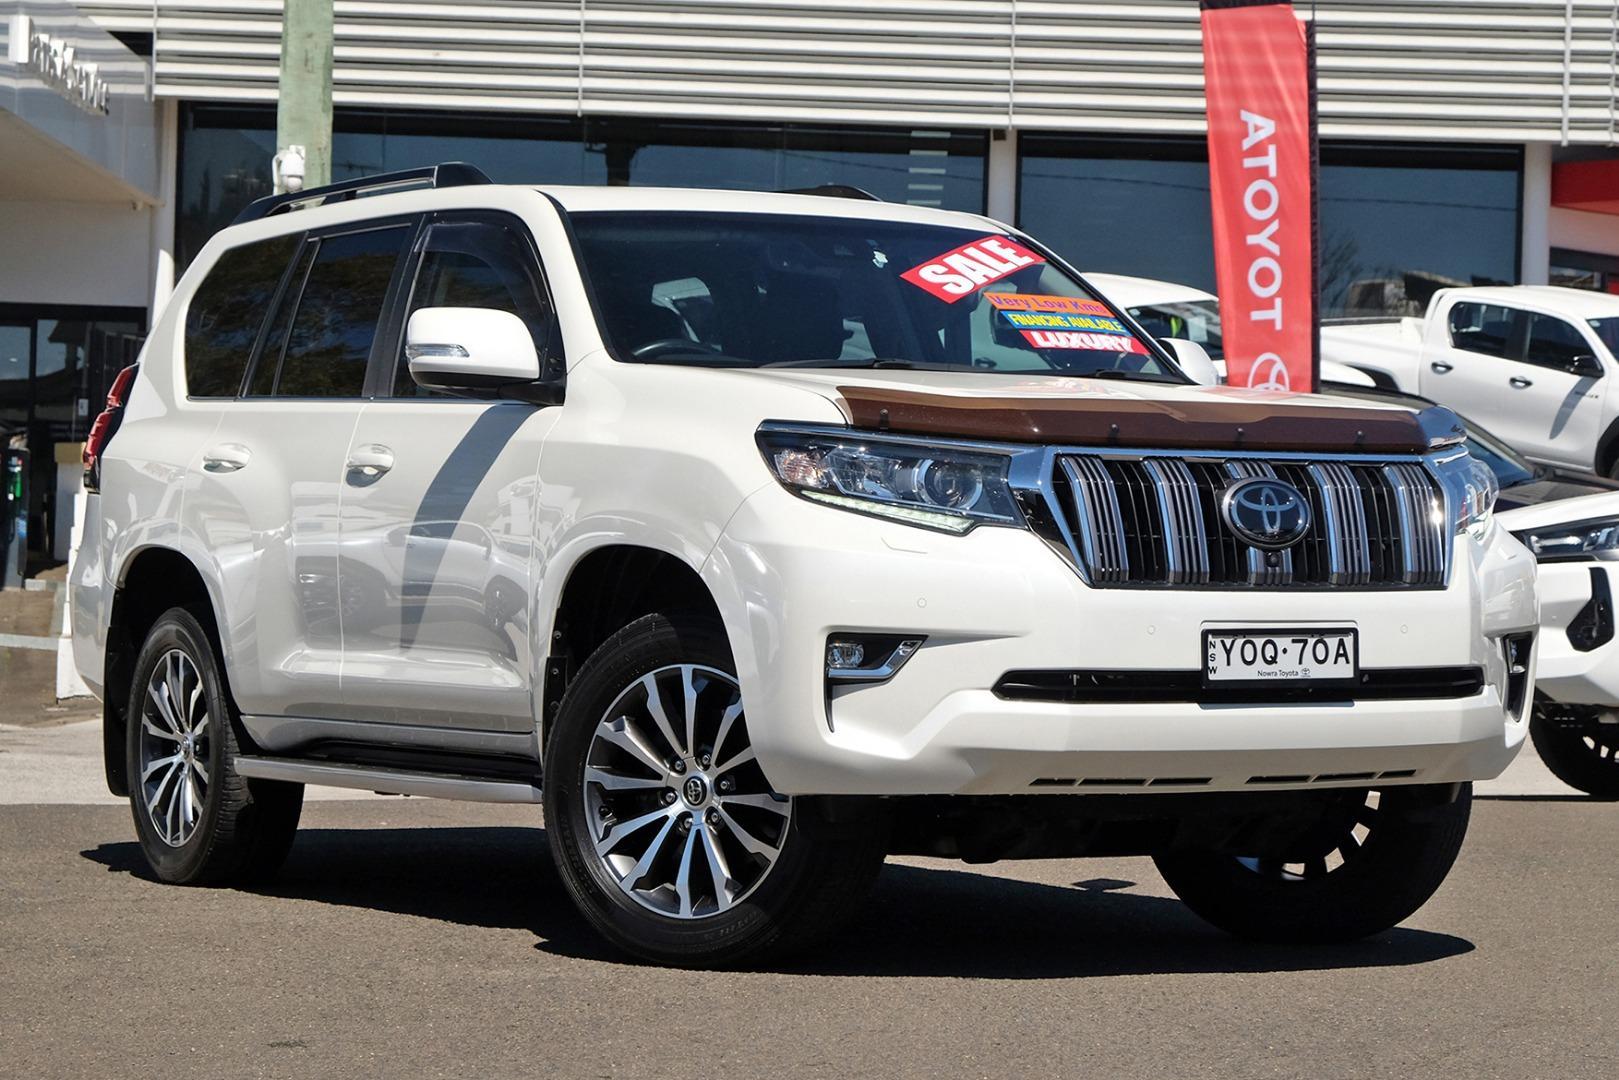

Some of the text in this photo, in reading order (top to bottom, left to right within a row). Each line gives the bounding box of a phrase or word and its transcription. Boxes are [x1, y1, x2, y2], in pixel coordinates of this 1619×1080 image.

[918, 239, 1035, 295] SALE
[989, 295, 1108, 314] Very Low Kms
[1007, 313, 1127, 332] FINANCING AVAILABLE
[1030, 331, 1134, 352] LUXURY
[1257, 669, 1278, 677] Nowra
[1279, 669, 1299, 679] Toyota
